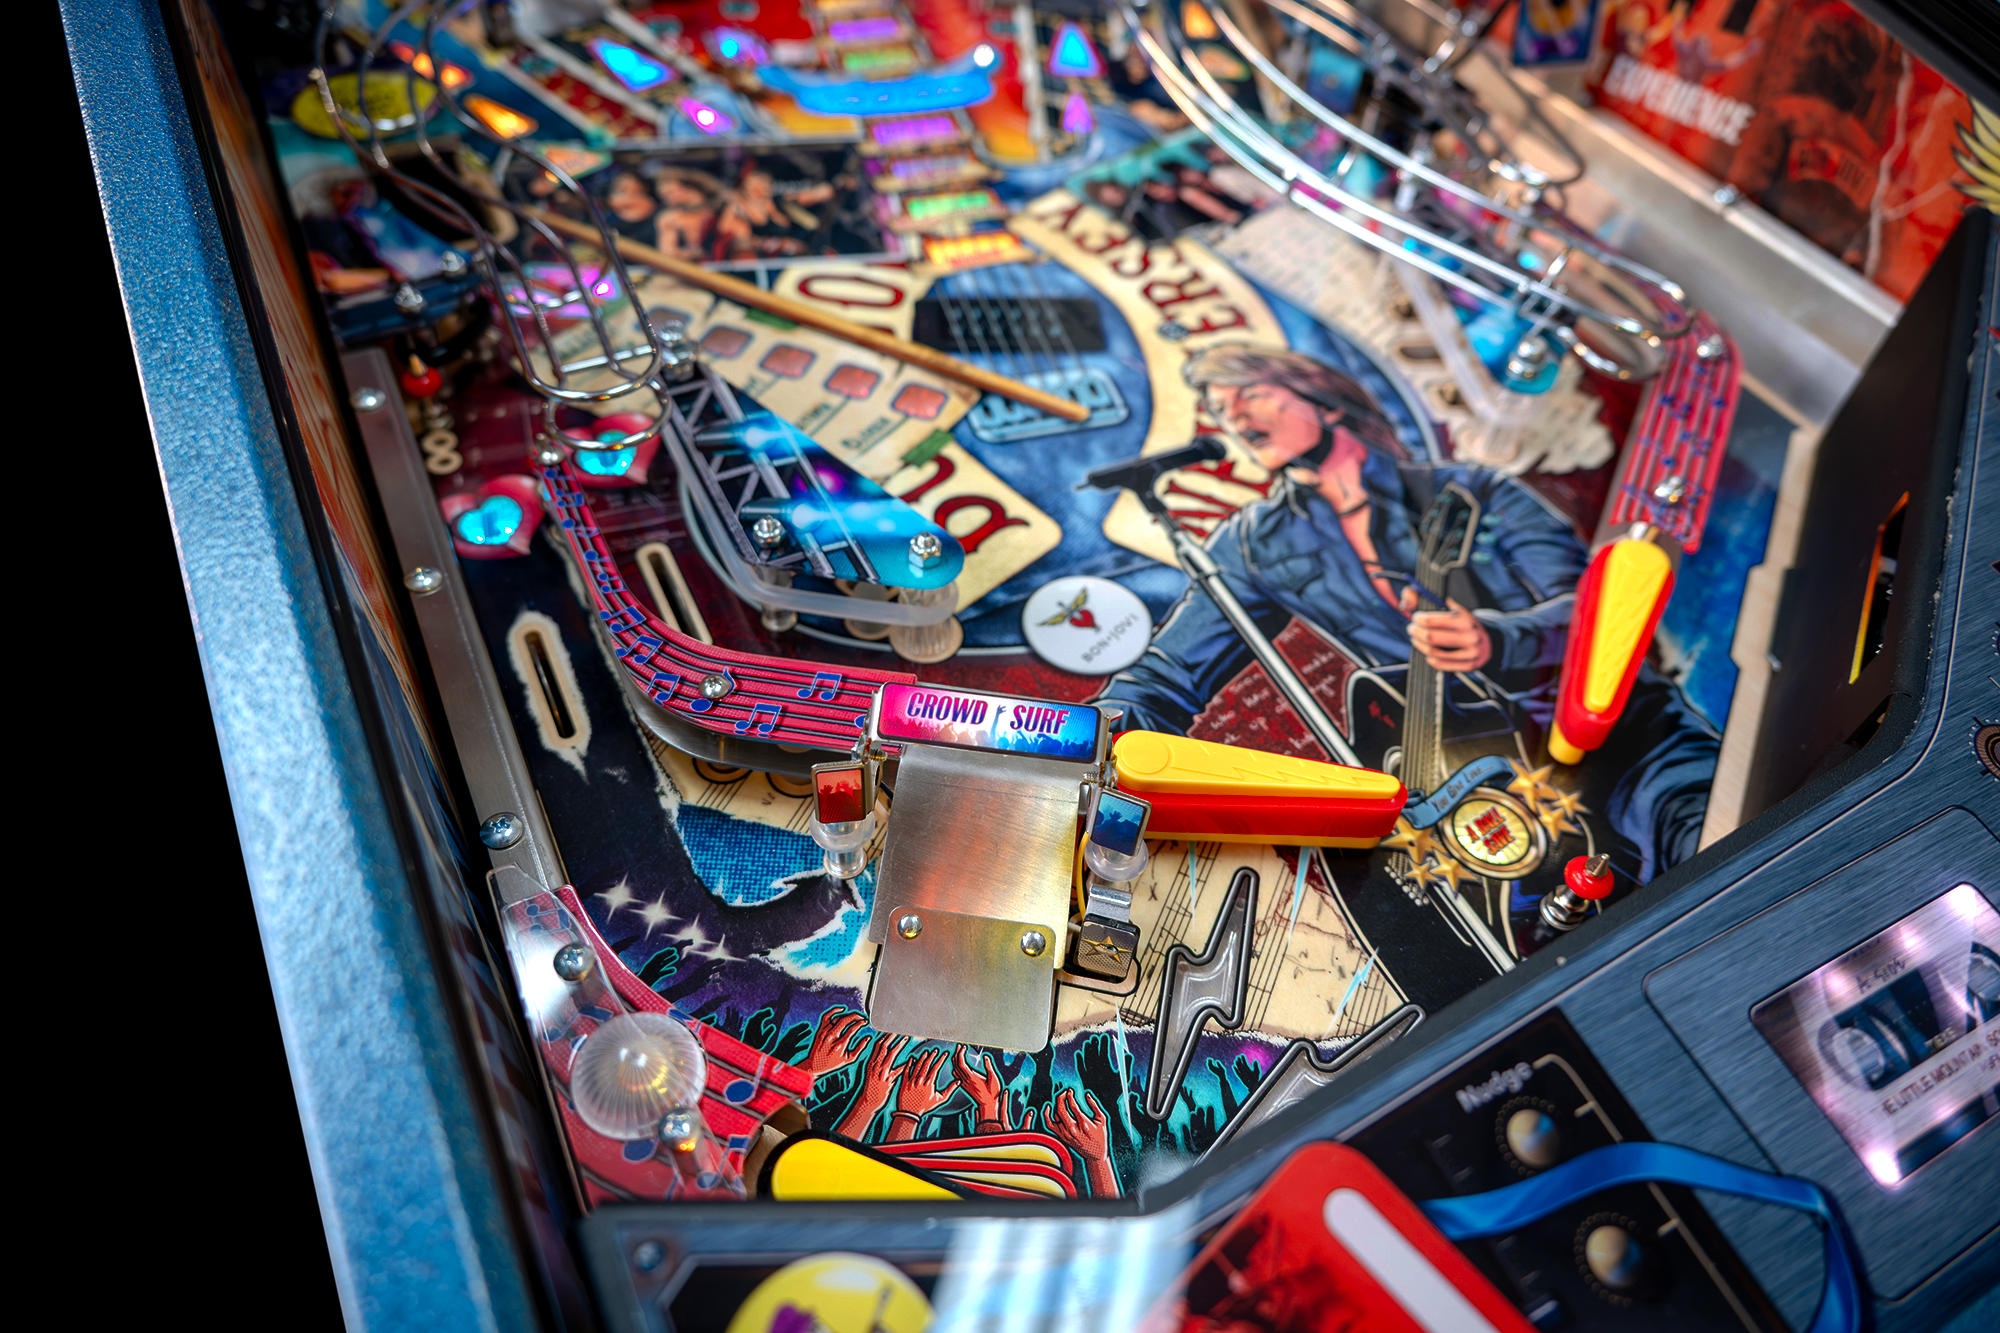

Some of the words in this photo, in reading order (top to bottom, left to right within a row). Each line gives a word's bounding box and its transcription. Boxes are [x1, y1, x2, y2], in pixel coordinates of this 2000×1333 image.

[1604, 54, 1756, 146] EXPERIENCE
[907, 692, 988, 725] CROWD
[1010, 704, 1069, 735] SURF
[1466, 825, 1480, 844] A
[1474, 807, 1505, 836] BALL
[1484, 825, 1515, 855] SAVE
[1455, 1061, 1533, 1114] Nudge
